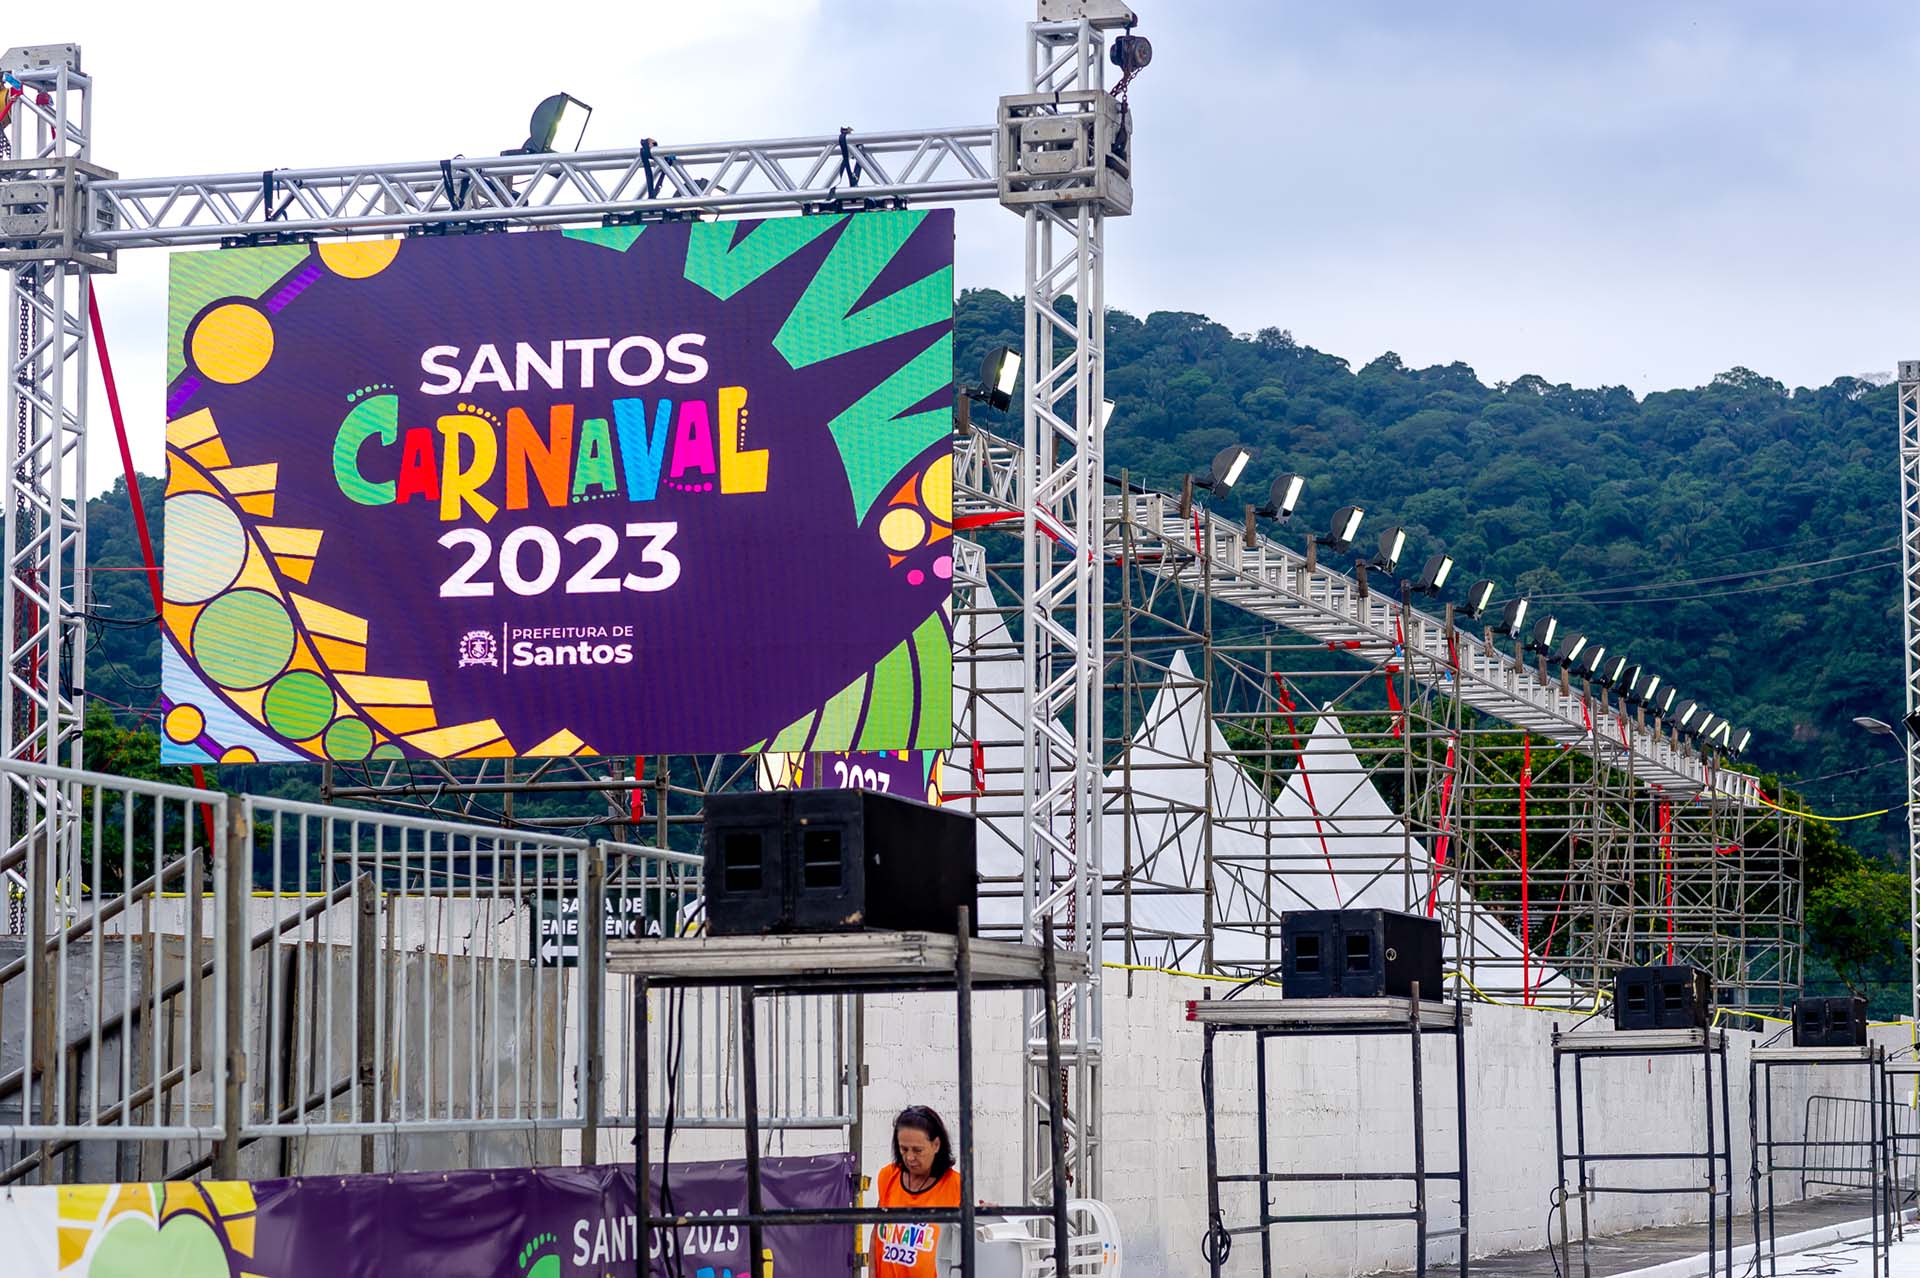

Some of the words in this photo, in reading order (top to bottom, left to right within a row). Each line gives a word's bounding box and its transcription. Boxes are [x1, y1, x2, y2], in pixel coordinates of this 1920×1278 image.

[419, 333, 709, 395] SANTOS
[332, 385, 770, 524] CARNAVAL
[437, 521, 681, 598] 2023
[512, 626, 608, 639] PREFEITURA
[612, 625, 634, 637] DE
[512, 641, 634, 667] Santos
[561, 897, 614, 913] SAA
[619, 897, 642, 913] DE
[541, 916, 662, 936] EMEÊNA
[682, 1208, 739, 1256] 2023
[884, 1246, 916, 1264] 2023
